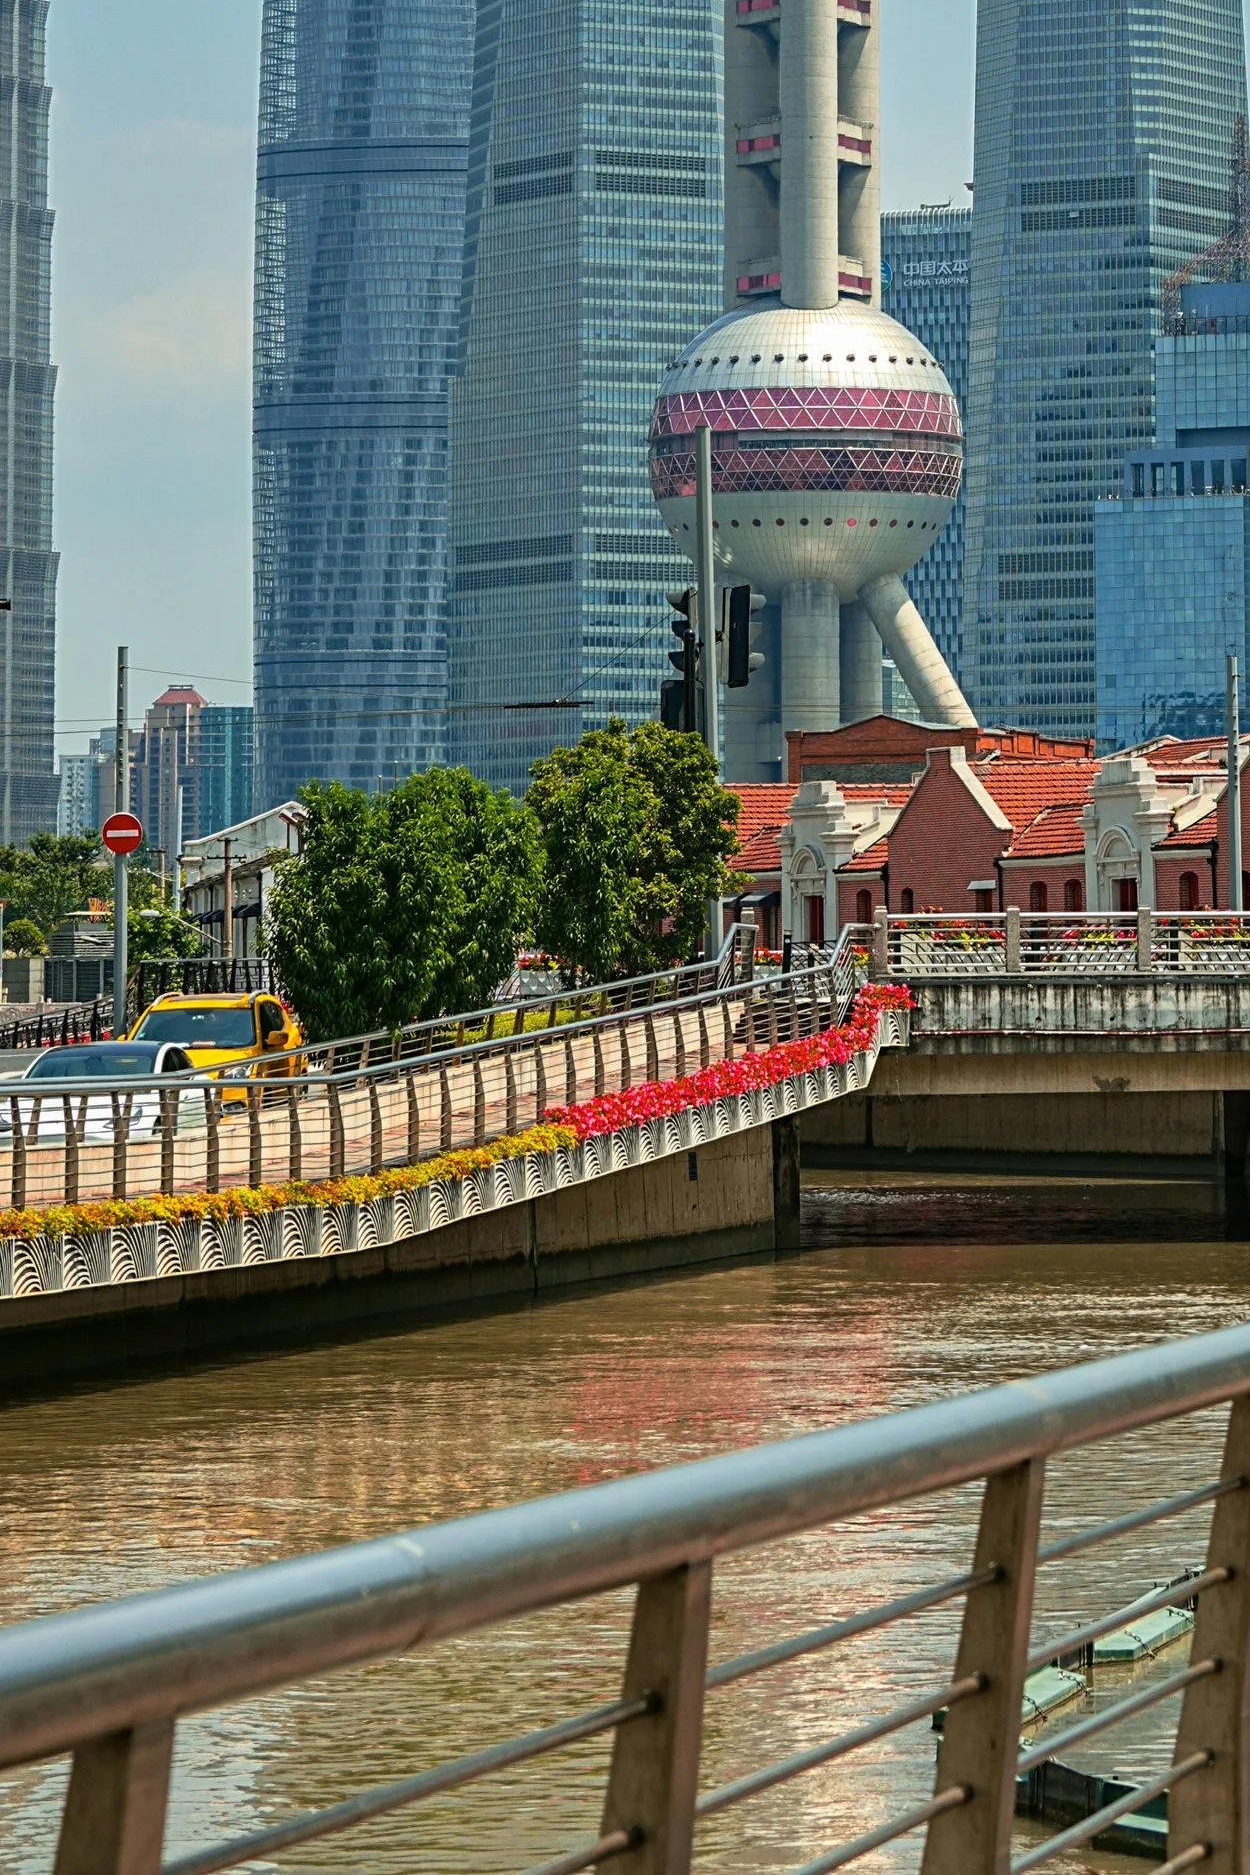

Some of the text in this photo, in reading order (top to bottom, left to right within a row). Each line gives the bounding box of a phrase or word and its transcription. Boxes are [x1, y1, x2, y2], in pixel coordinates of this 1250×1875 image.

[903, 259, 969, 276] 中国太平
[903, 276, 969, 287] CHINA TAIPING
